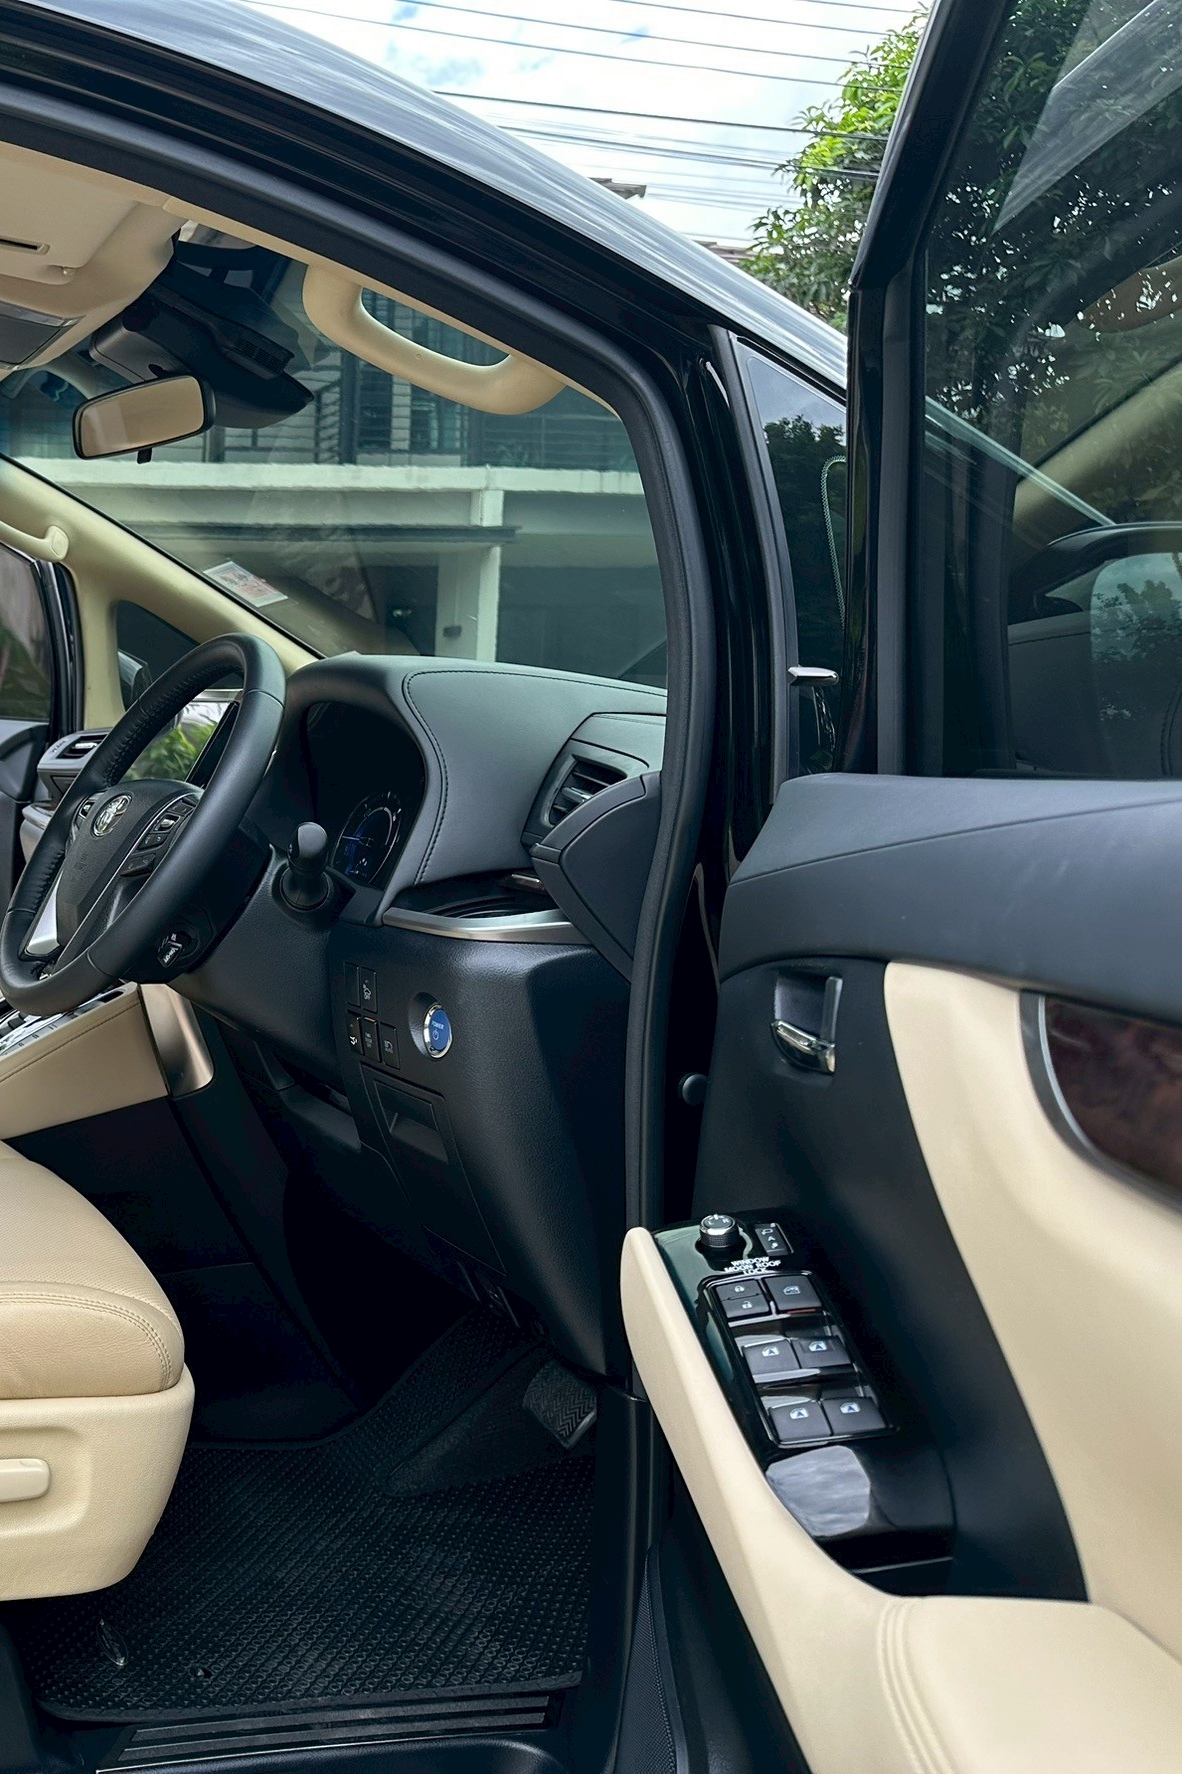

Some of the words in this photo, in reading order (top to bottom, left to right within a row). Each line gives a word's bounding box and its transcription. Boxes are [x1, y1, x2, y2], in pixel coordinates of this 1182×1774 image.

[724, 1264, 754, 1273] MOON
[755, 1260, 781, 1269] ROOF
[731, 1257, 770, 1268] WINDOW
[743, 1267, 767, 1275] LOCK
